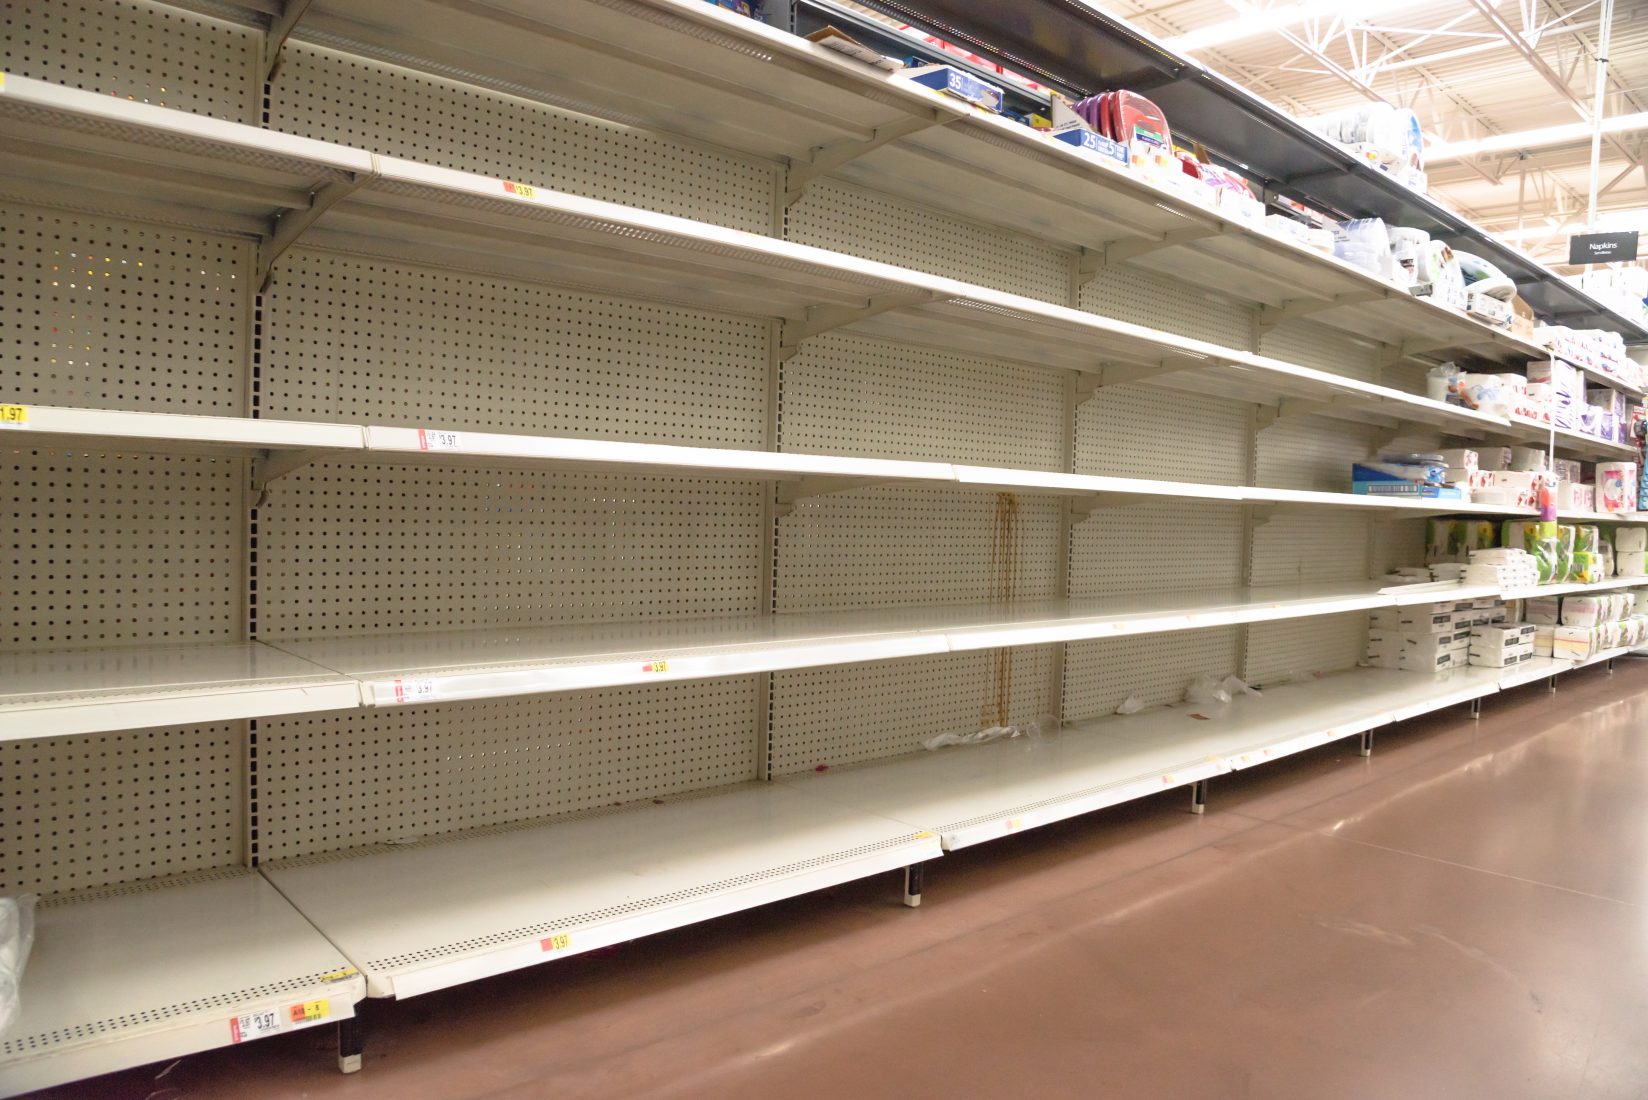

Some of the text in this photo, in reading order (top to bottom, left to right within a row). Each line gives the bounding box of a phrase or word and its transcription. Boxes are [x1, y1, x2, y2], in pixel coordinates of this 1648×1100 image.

[949, 72, 961, 89] 35
[1083, 132, 1096, 149] 25
[1589, 241, 1618, 251] Napkins
